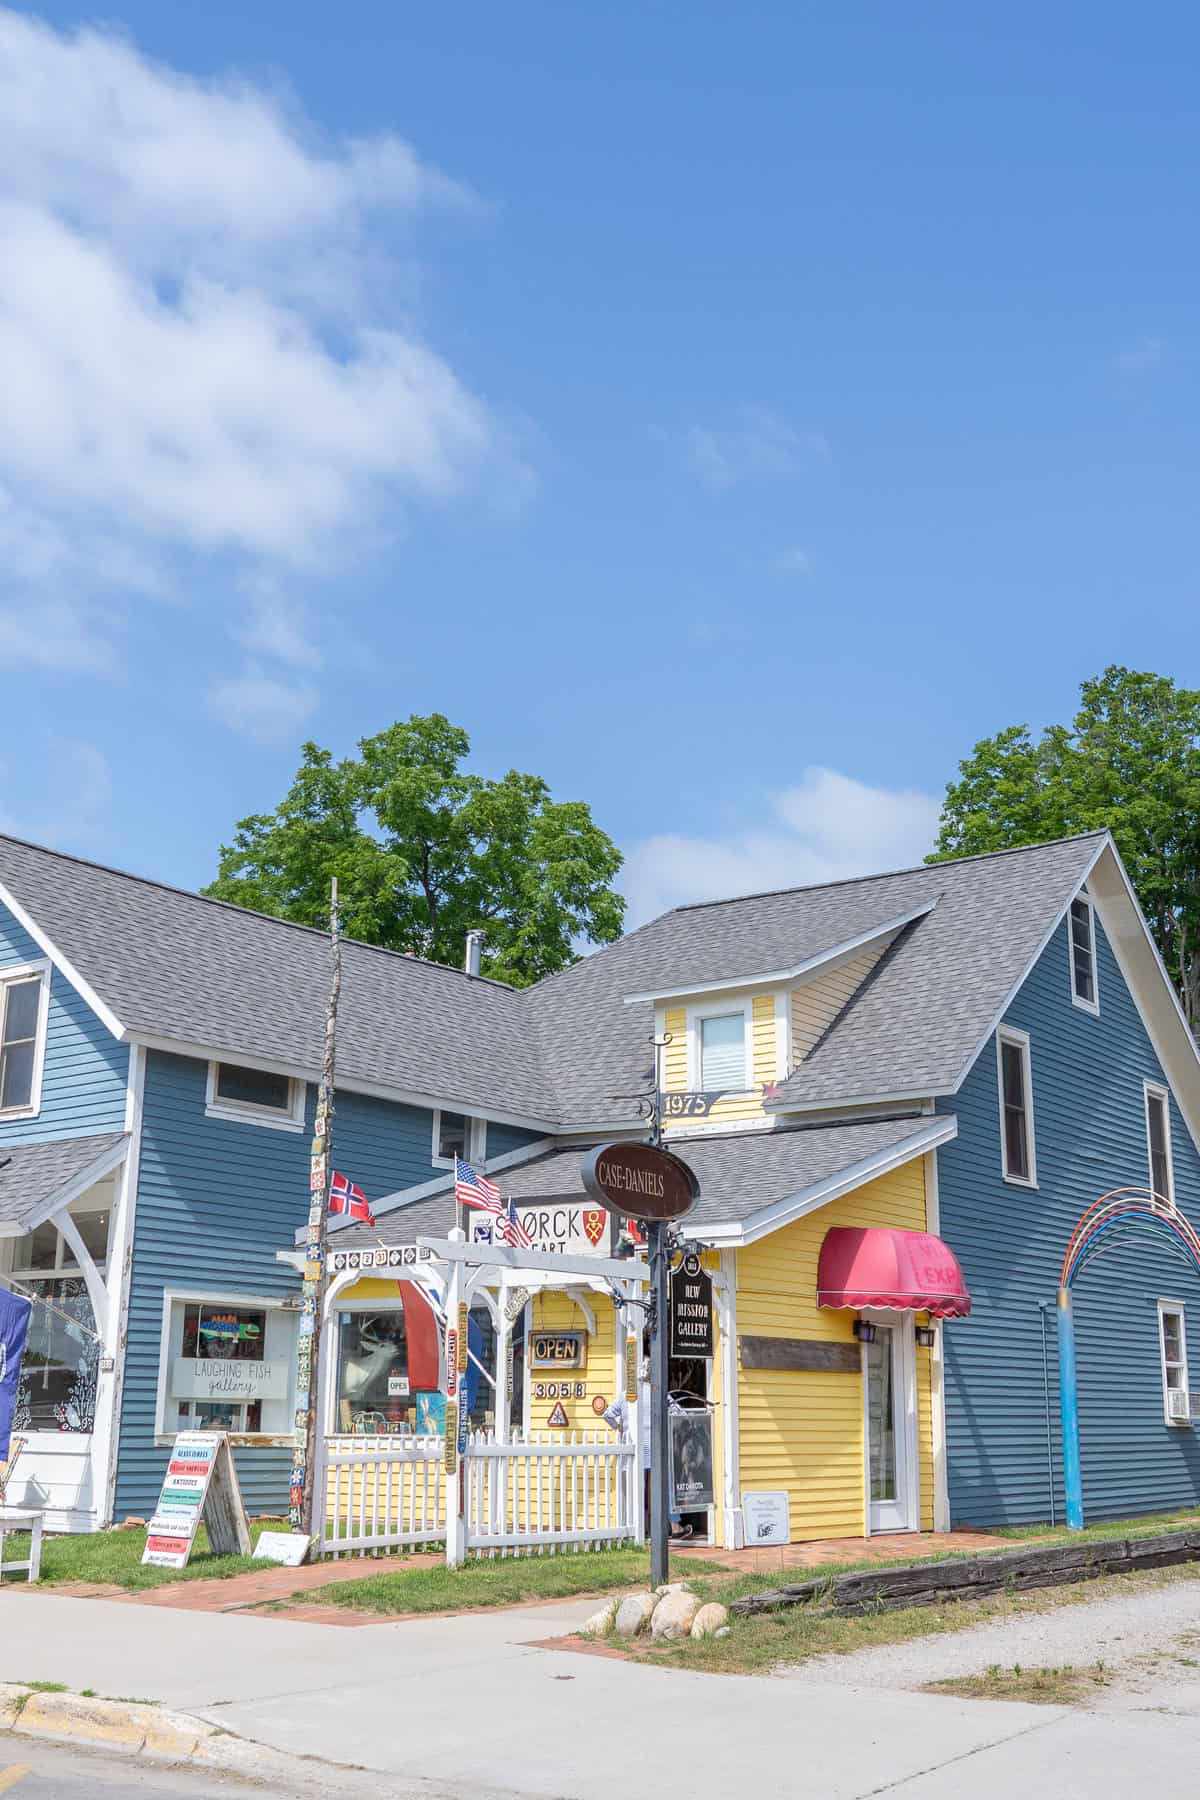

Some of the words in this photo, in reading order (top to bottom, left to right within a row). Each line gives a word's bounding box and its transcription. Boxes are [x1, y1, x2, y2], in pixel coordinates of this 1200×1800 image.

[664, 1095, 706, 1116] 1975
[495, 1210, 580, 1240] SØRCK
[685, 1285, 700, 1298] NEW
[677, 1303, 708, 1318] MISSION
[678, 1322, 708, 1336] GALLERY
[536, 1339, 577, 1359] OPEN
[194, 1360, 241, 1378] LAUGHING
[249, 1363, 271, 1379] FISH
[209, 1378, 253, 1396] gallery
[390, 1382, 408, 1390] OPEN
[536, 1383, 583, 1397] 3058
